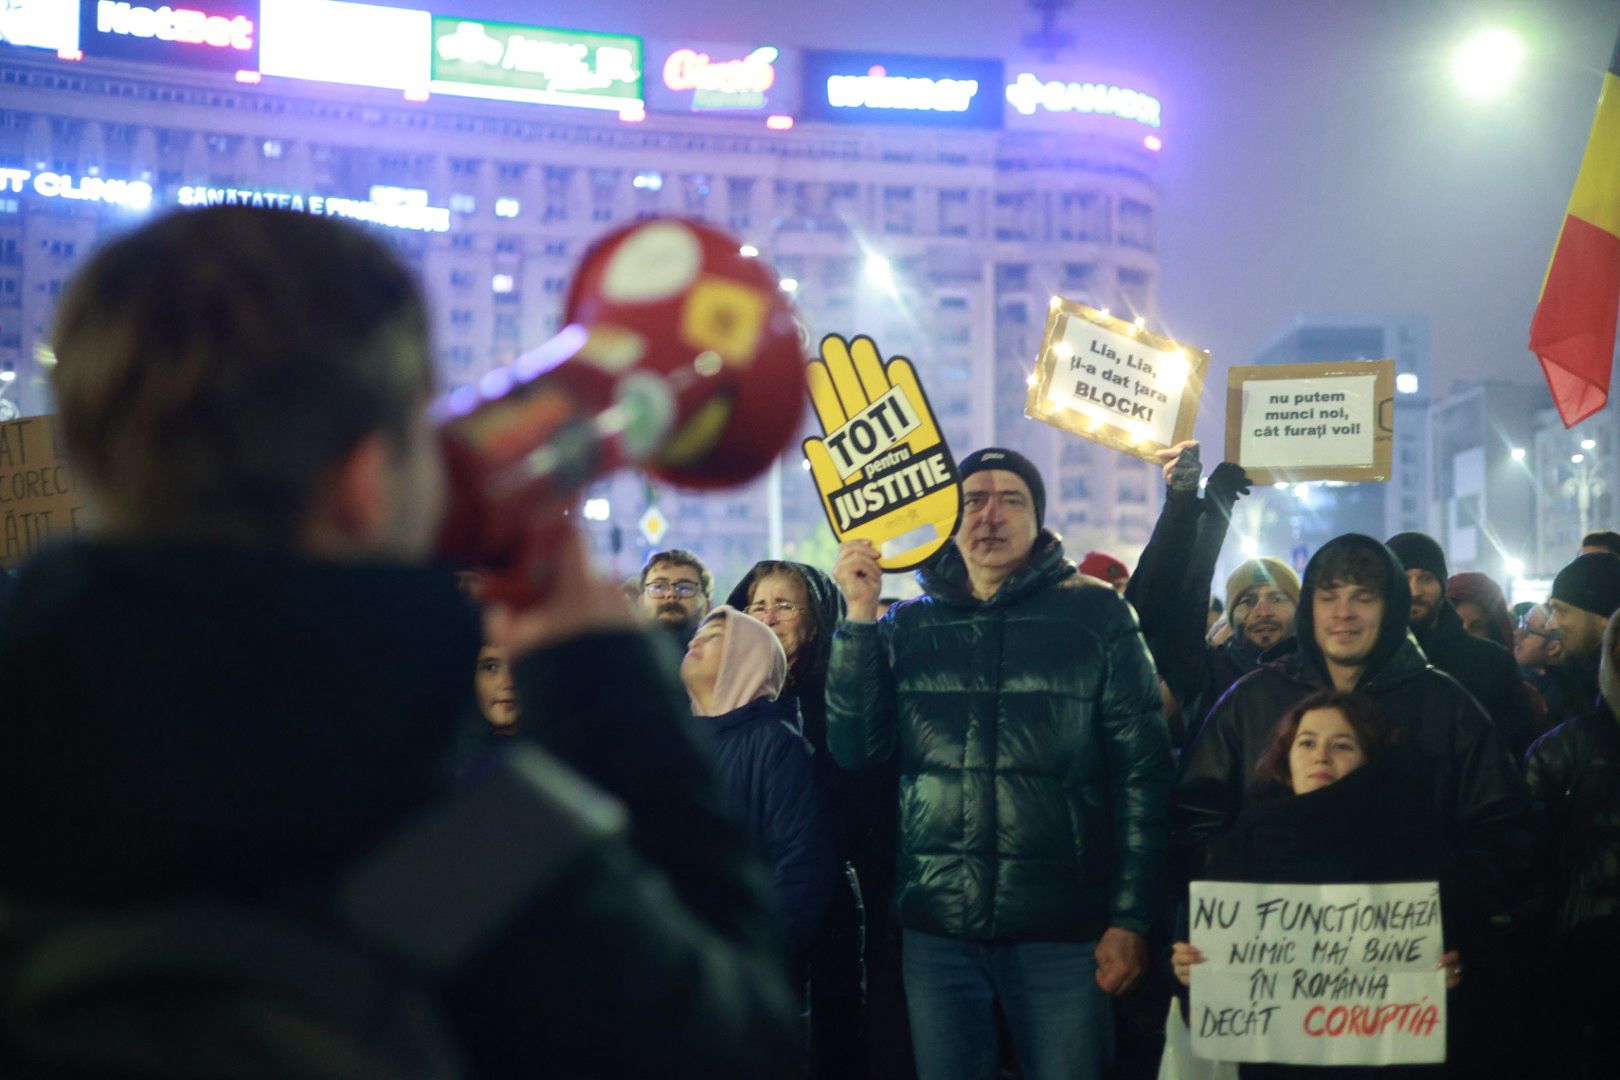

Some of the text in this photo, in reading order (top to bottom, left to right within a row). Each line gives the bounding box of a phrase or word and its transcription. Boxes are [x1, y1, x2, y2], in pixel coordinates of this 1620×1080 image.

[1090, 340, 1157, 379] Lia, Lia,
[1102, 368, 1131, 388] dat
[1074, 380, 1154, 422] BLOCK!
[1265, 407, 1349, 421] munci noi,
[1269, 392, 1346, 406] nu putem
[828, 396, 910, 468] TOȚI
[1254, 422, 1361, 439] cât furați voi!
[864, 447, 911, 480] pentru
[834, 452, 951, 531] JUSTIȚIE
[1192, 897, 1240, 930] NU
[1229, 935, 1430, 965] NIMIC MAI BINE
[1249, 967, 1278, 1000] ÎN
